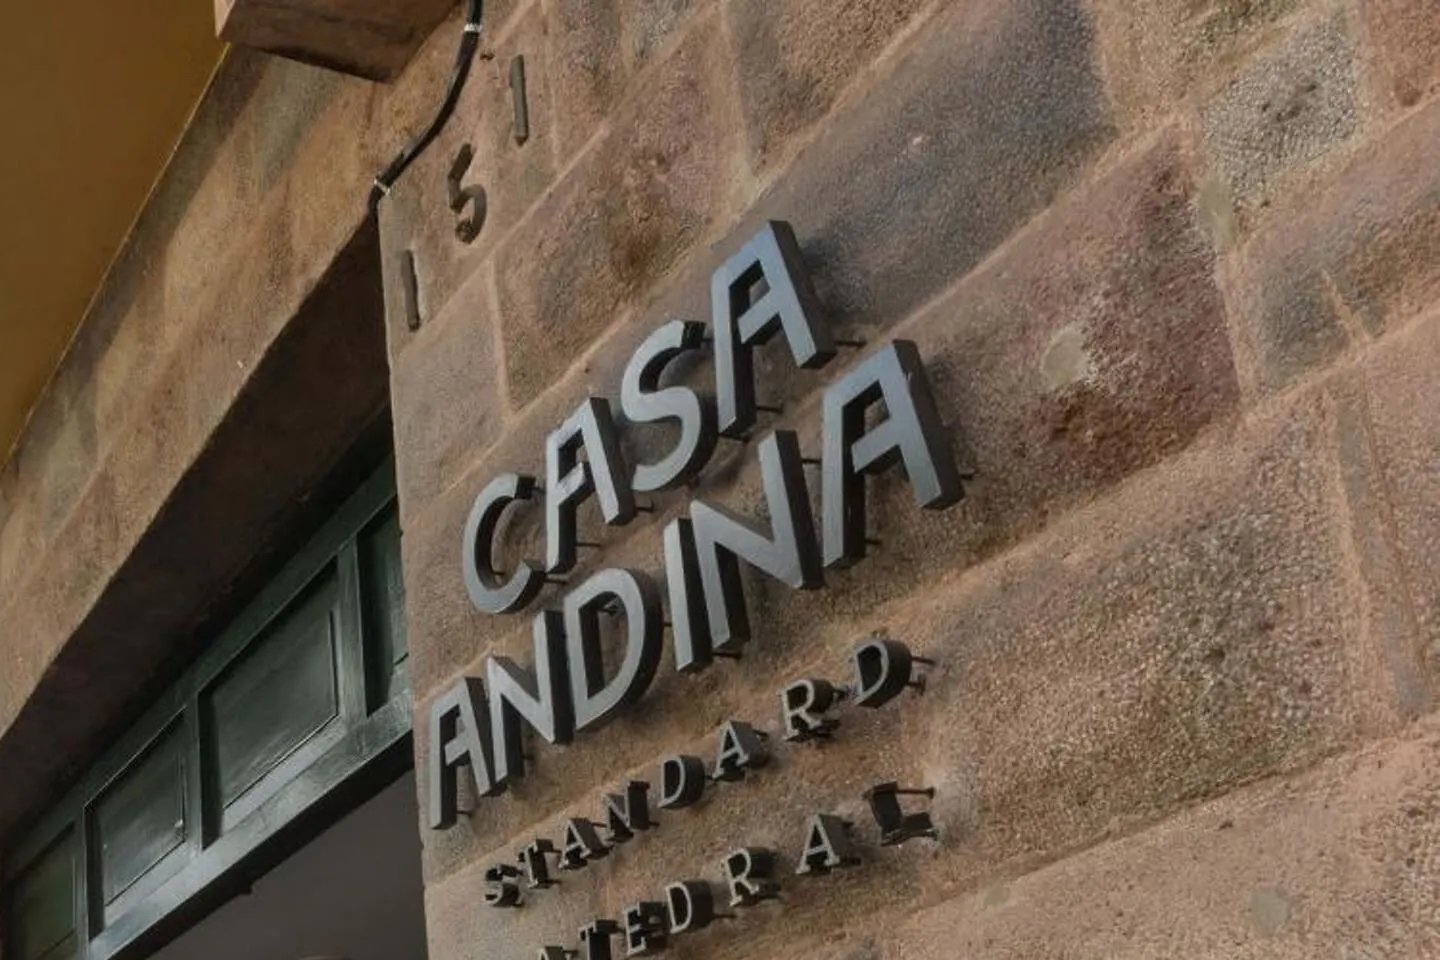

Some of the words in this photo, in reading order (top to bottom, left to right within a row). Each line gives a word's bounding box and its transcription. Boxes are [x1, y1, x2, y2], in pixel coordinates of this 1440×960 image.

[426, 337, 966, 831] ANDINA
[462, 219, 838, 615] CASA
[484, 636, 914, 910] STANDARD
